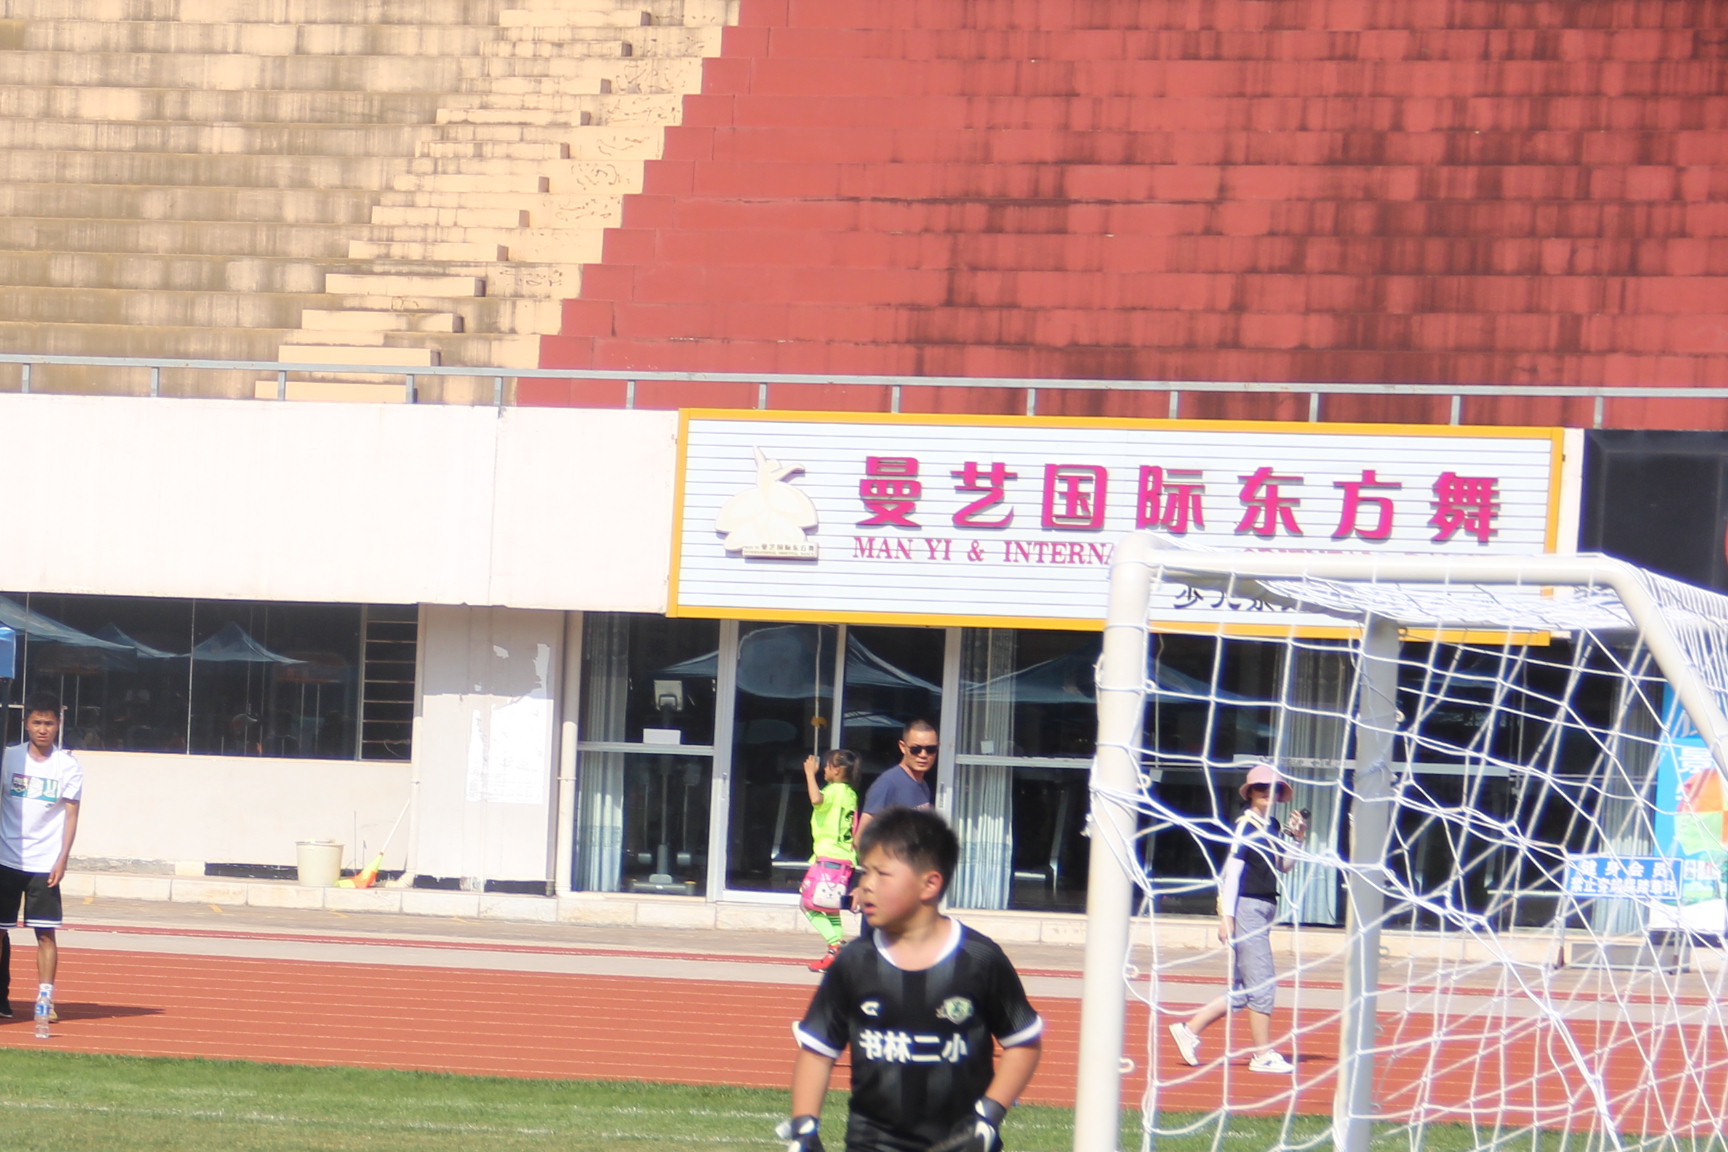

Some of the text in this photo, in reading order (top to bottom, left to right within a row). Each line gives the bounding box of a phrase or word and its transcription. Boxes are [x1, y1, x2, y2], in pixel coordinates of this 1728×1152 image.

[856, 454, 1501, 543] 曼艺国际东方舞
[852, 536, 913, 560] MAN
[924, 537, 952, 561] YI
[966, 539, 985, 562] &
[858, 1028, 969, 1064] 书林二小
